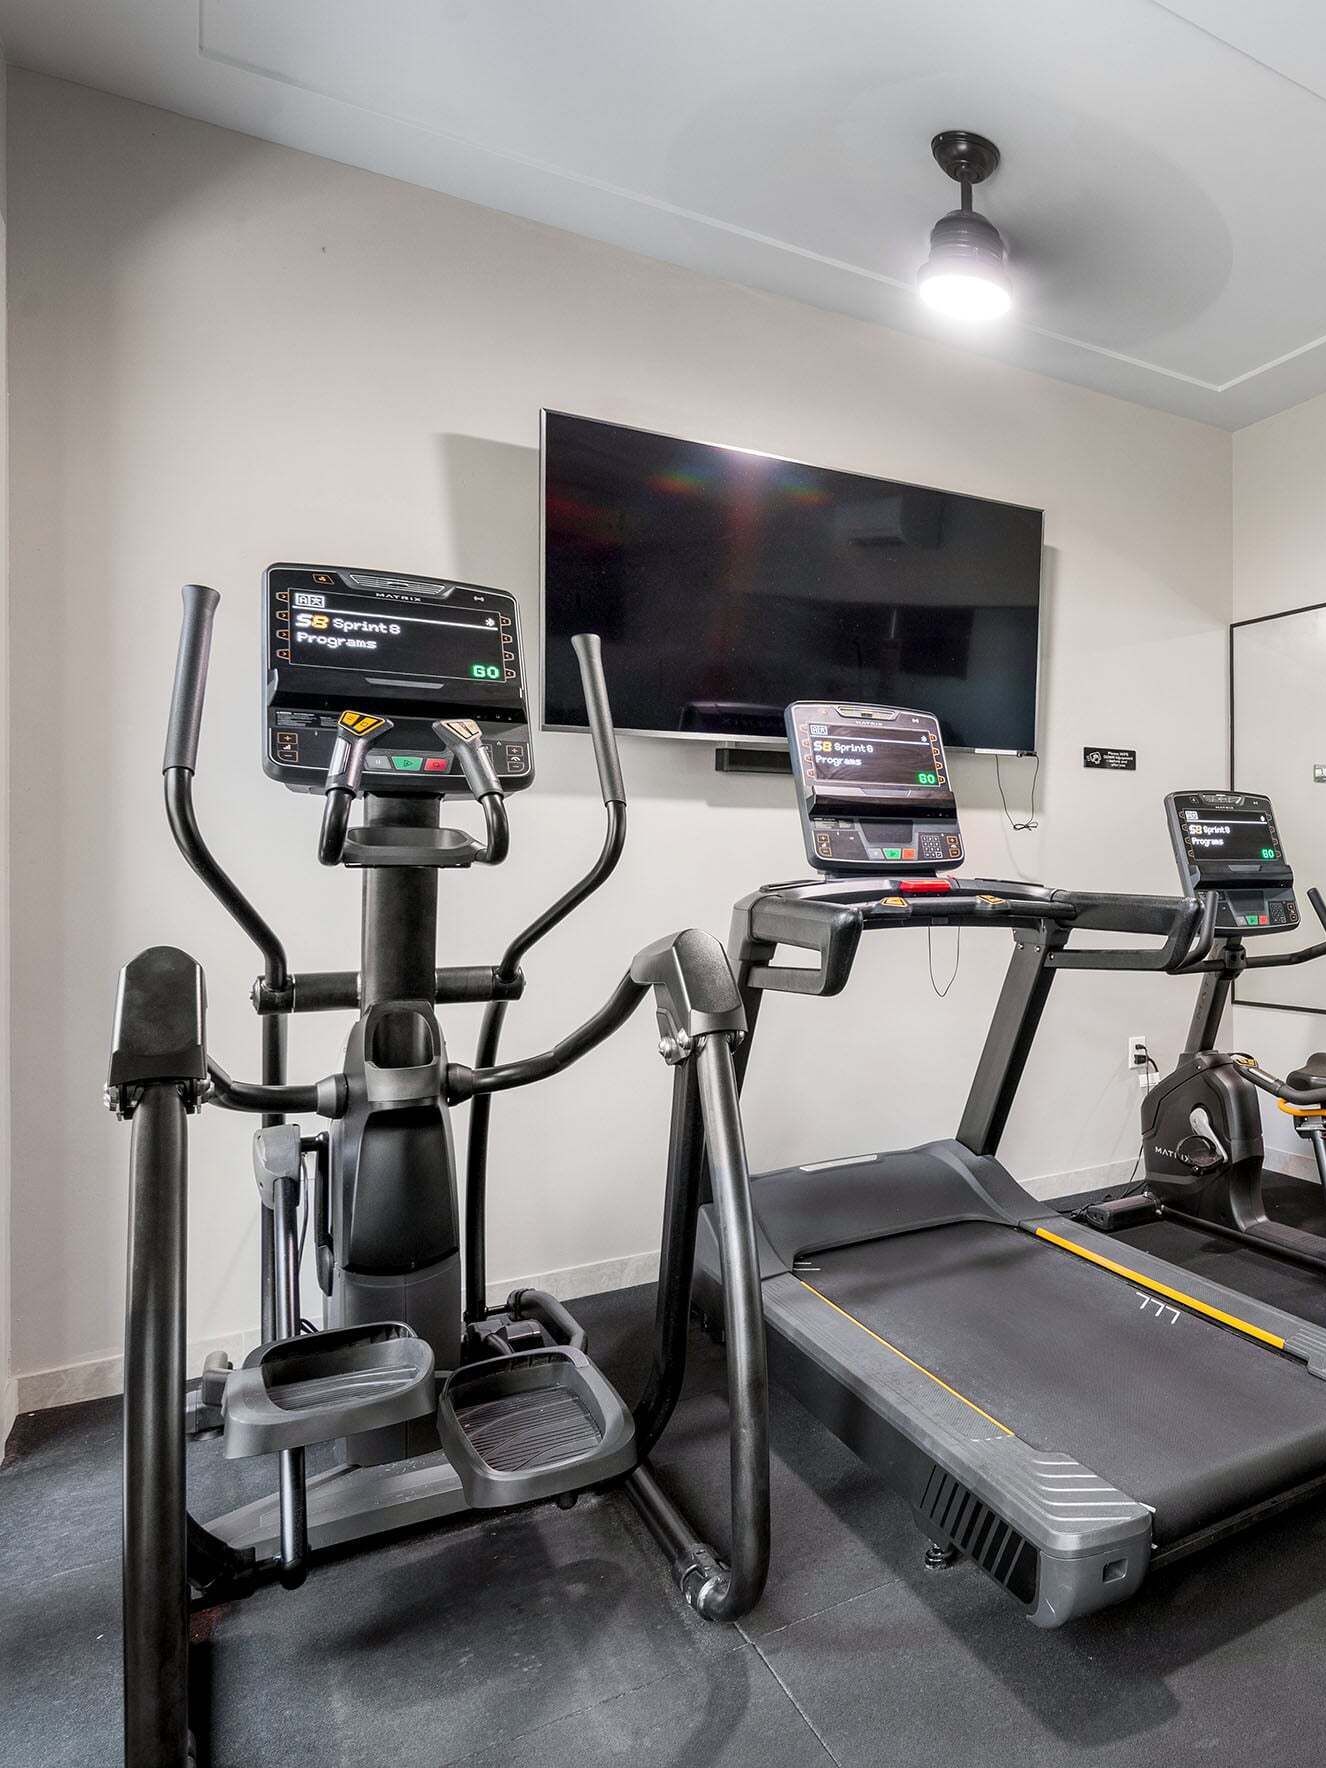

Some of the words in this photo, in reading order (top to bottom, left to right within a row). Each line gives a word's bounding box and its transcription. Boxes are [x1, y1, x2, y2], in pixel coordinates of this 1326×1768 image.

[376, 592, 421, 602] MATRIX
[333, 618, 387, 634] Sprint
[296, 632, 377, 649] Programs
[472, 665, 499, 679] GO
[815, 755, 862, 767] Programs
